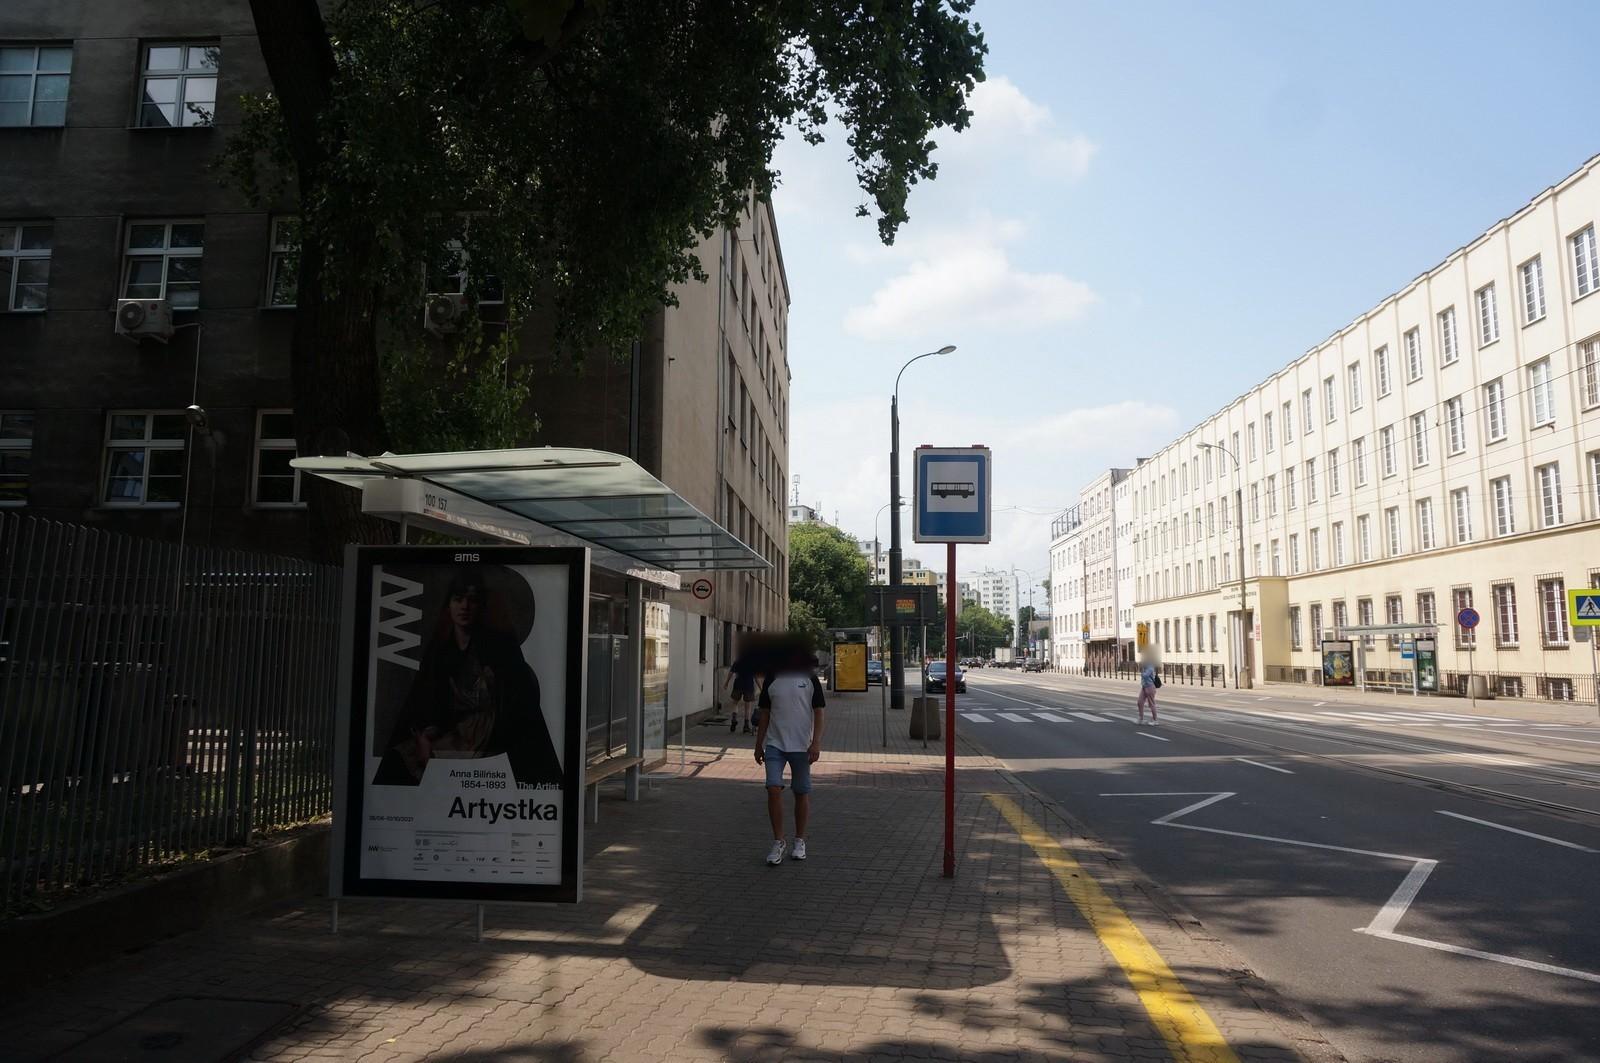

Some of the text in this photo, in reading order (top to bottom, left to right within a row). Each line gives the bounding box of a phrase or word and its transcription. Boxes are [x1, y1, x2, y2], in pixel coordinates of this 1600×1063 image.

[425, 494, 436, 507] 100
[454, 552, 480, 562] ams
[449, 769, 472, 778] Anna
[448, 796, 558, 824] Artystka
